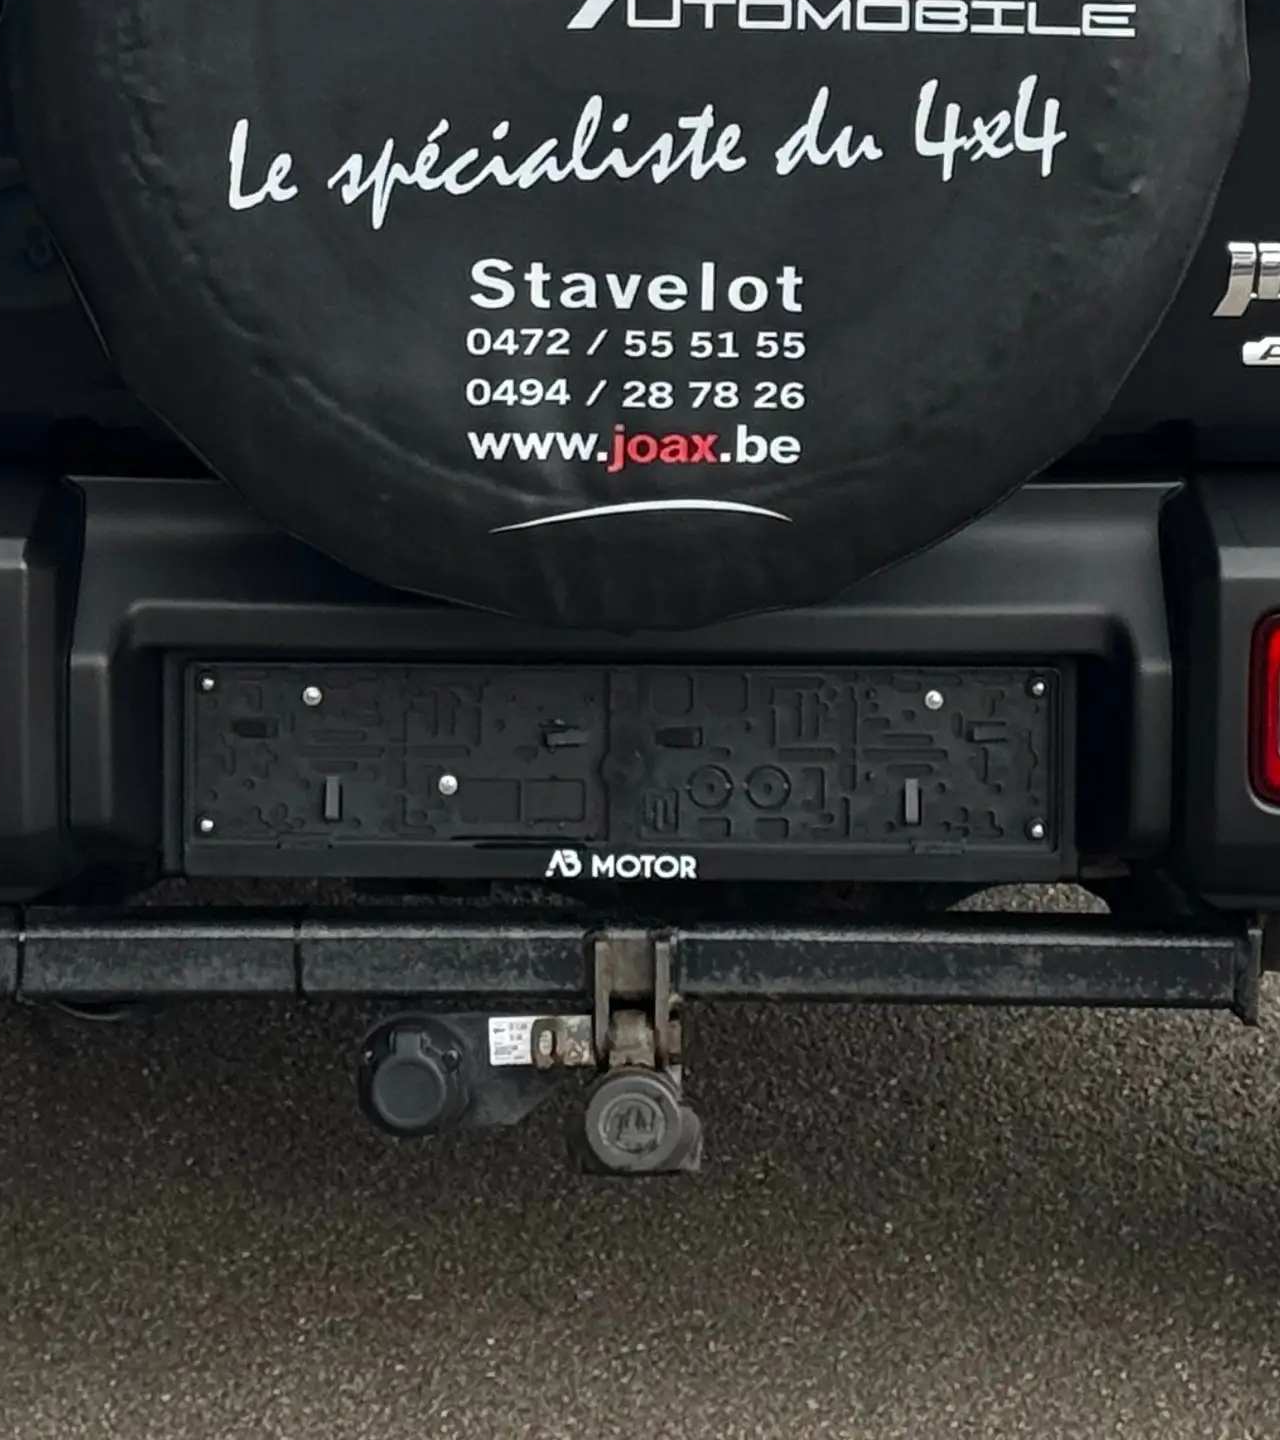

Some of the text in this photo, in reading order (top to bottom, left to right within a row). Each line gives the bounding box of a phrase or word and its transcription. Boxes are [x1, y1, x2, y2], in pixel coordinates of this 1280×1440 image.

[228, 74, 1068, 230] Le spécialiste du 4x4
[469, 257, 804, 313] Stavelot
[466, 327, 571, 356] 0472
[623, 329, 674, 359] 55
[689, 330, 740, 359] 51
[755, 331, 806, 359] 55
[465, 378, 571, 407] 0494
[621, 380, 674, 410] 28
[688, 380, 740, 409] 78
[753, 381, 805, 410] 26
[467, 423, 801, 473] www.joax.be
[591, 853, 697, 879] MOTOR
